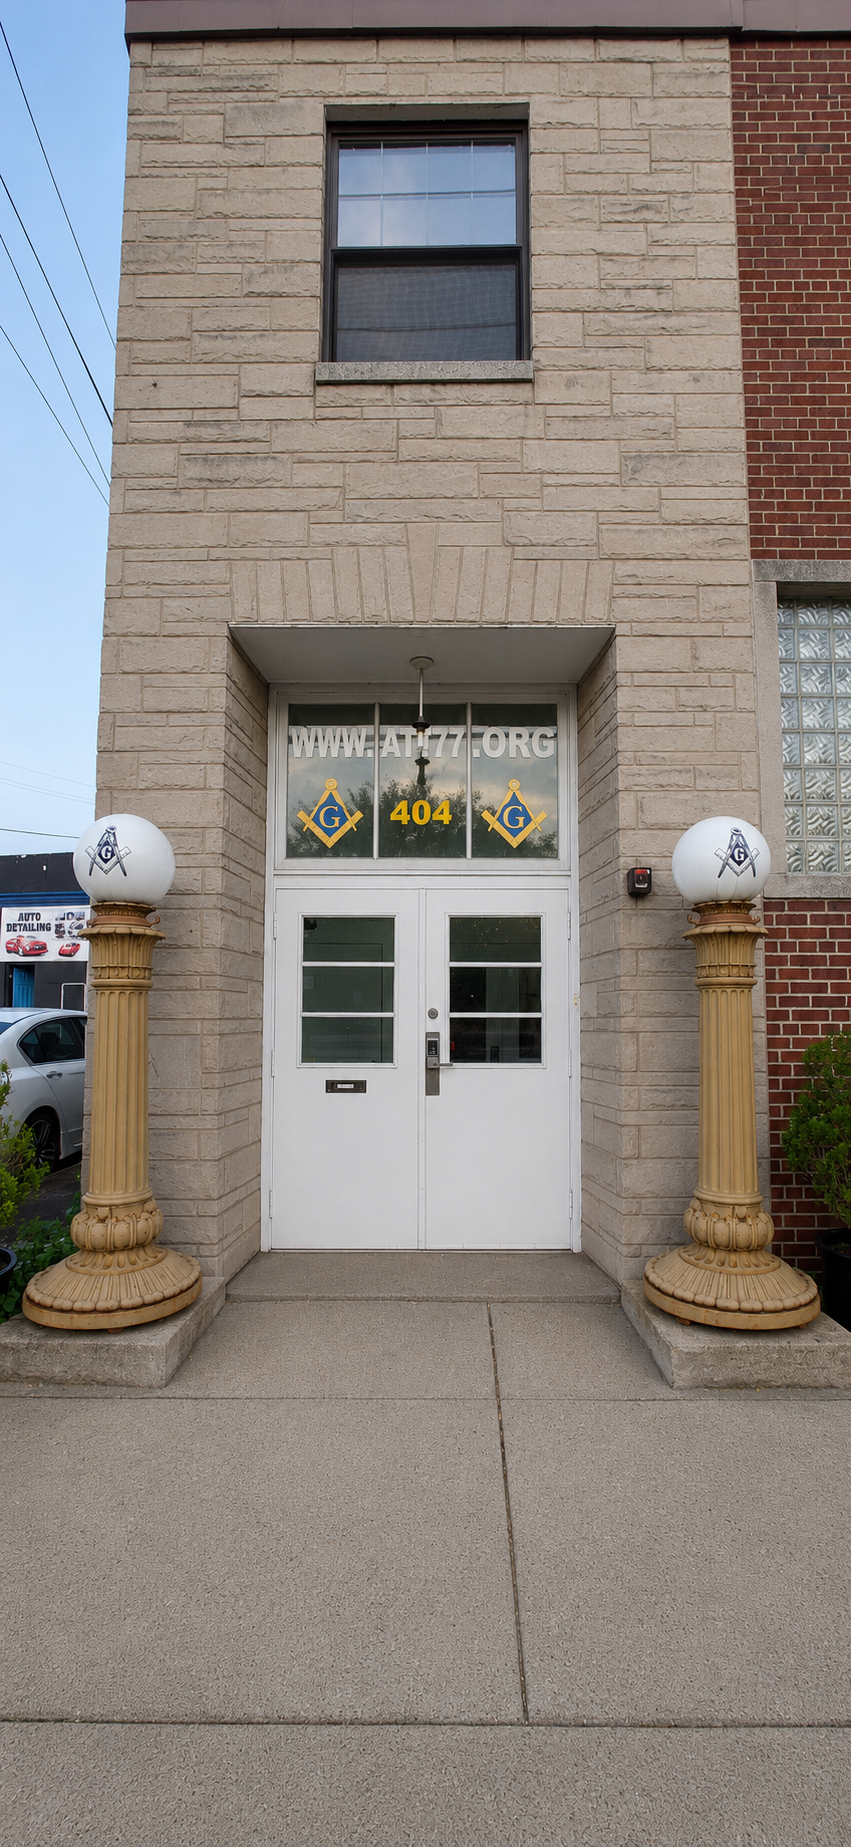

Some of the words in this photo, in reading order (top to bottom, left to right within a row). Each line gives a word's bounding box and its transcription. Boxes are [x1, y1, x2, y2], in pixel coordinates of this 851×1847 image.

[319, 805, 341, 828] G
[390, 800, 452, 825] 404
[503, 805, 525, 828] G
[101, 845, 112, 860] G
[735, 847, 745, 861] G
[18, 912, 41, 922] AUTO
[6, 922, 51, 932] DETAILING
